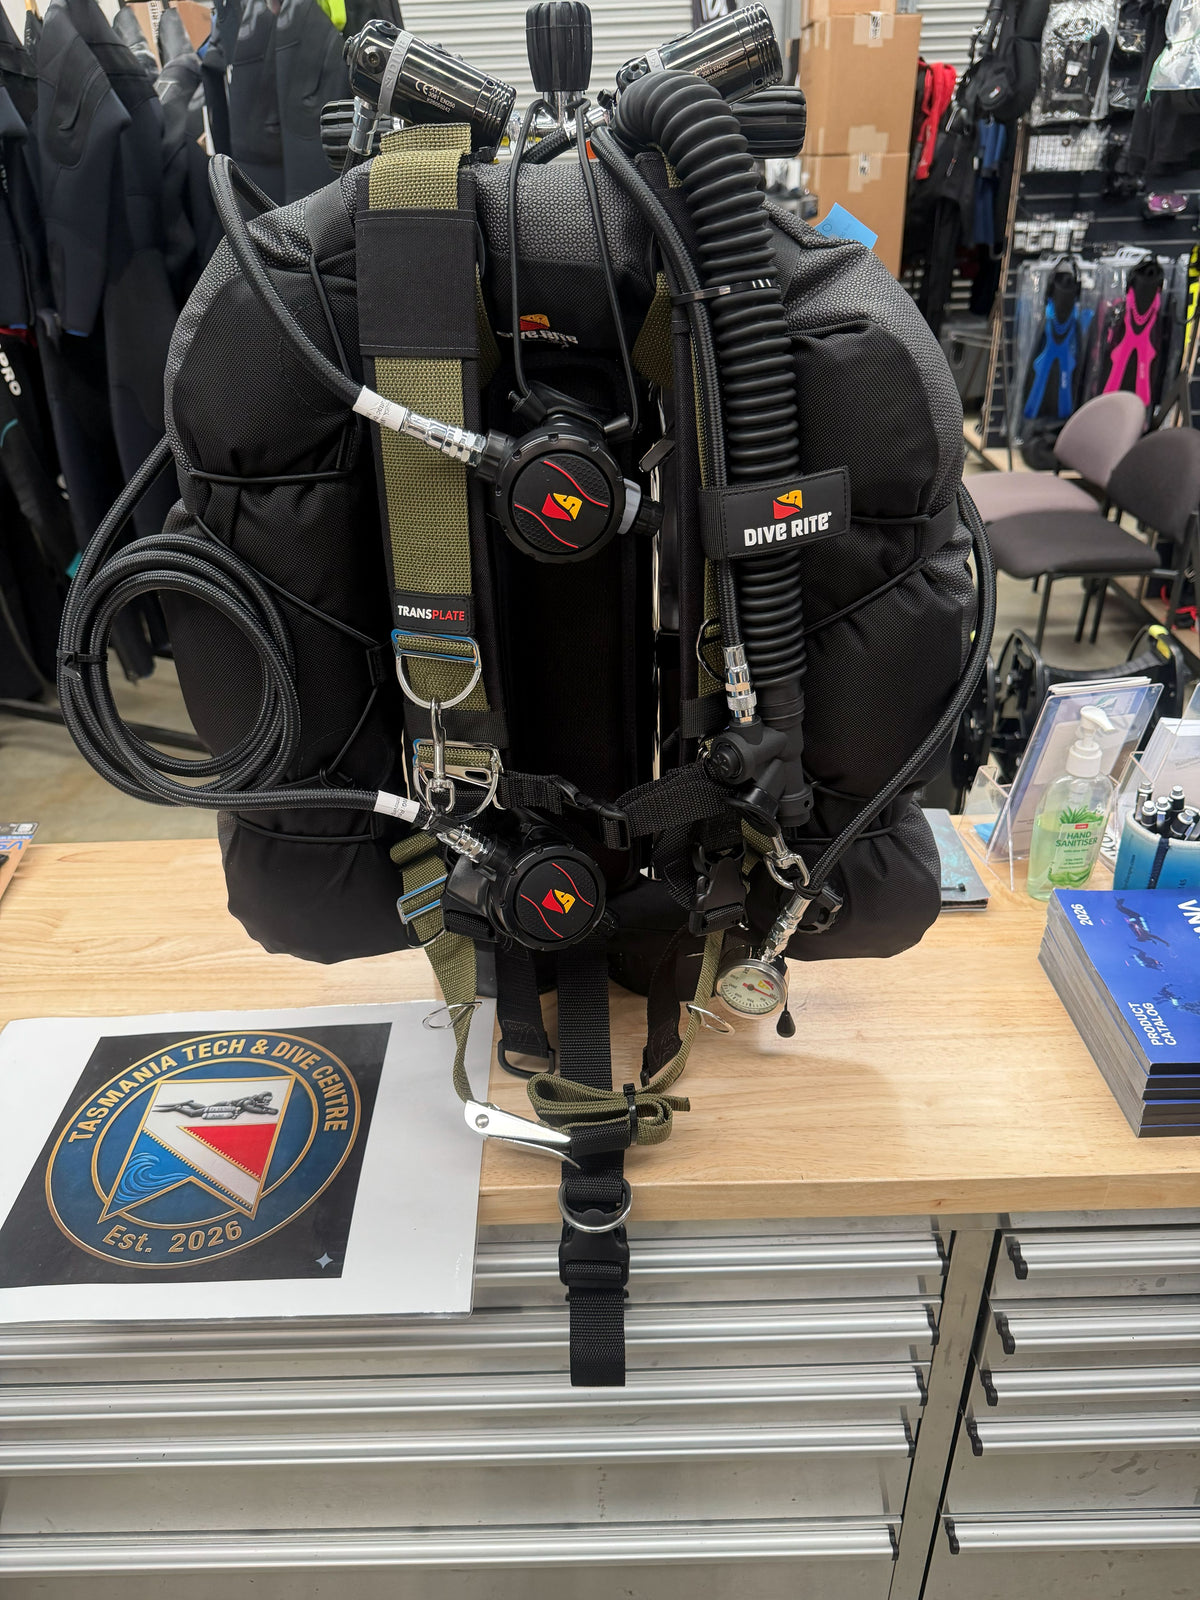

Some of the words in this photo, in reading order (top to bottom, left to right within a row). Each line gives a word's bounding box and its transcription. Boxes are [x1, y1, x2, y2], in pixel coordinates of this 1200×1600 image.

[0, 345, 22, 396] PRO
[744, 522, 788, 547] DIVE
[790, 512, 830, 538] RITE
[397, 604, 465, 621] TRANSPLATE
[1055, 836, 1098, 847] SANITISER
[1066, 831, 1092, 839] HAND
[1070, 903, 1094, 926] 2026
[1127, 1002, 1164, 1046] PRODUCT
[1142, 1002, 1177, 1046] CATALOG
[68, 1055, 178, 1143] TASMANIA
[181, 1038, 246, 1061] TECH
[250, 1038, 270, 1055] &
[270, 1041, 321, 1071] DIVE
[312, 1064, 348, 1132] CENTRE
[101, 1224, 153, 1253] Est.
[167, 1220, 243, 1253] 2026
